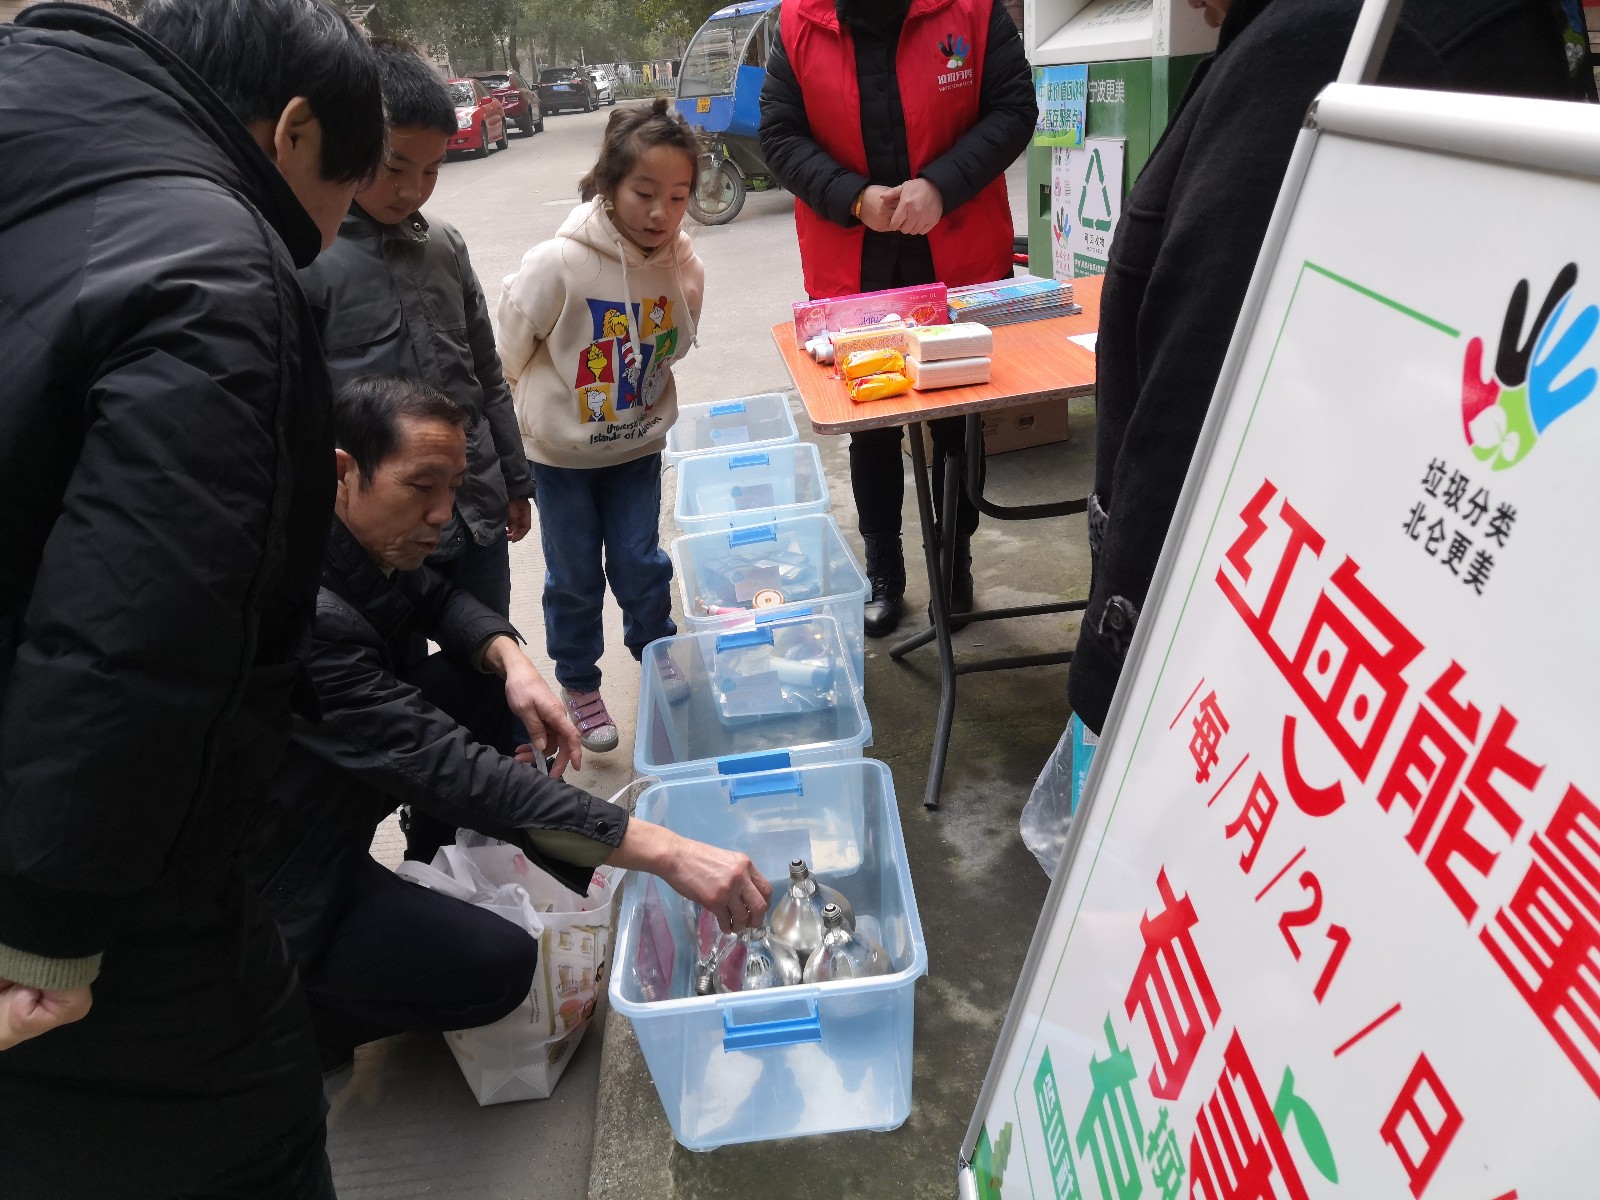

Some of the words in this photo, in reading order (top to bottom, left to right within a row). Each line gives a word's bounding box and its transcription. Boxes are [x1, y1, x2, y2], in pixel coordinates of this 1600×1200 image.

[1088, 79, 1125, 103] 宁波更美
[590, 432, 621, 445] Islands
[624, 429, 636, 440] of
[1421, 457, 1517, 548] 垃圾分类
[1403, 501, 1495, 596] 北仑更美
[1215, 477, 1600, 1101] 红色能量
